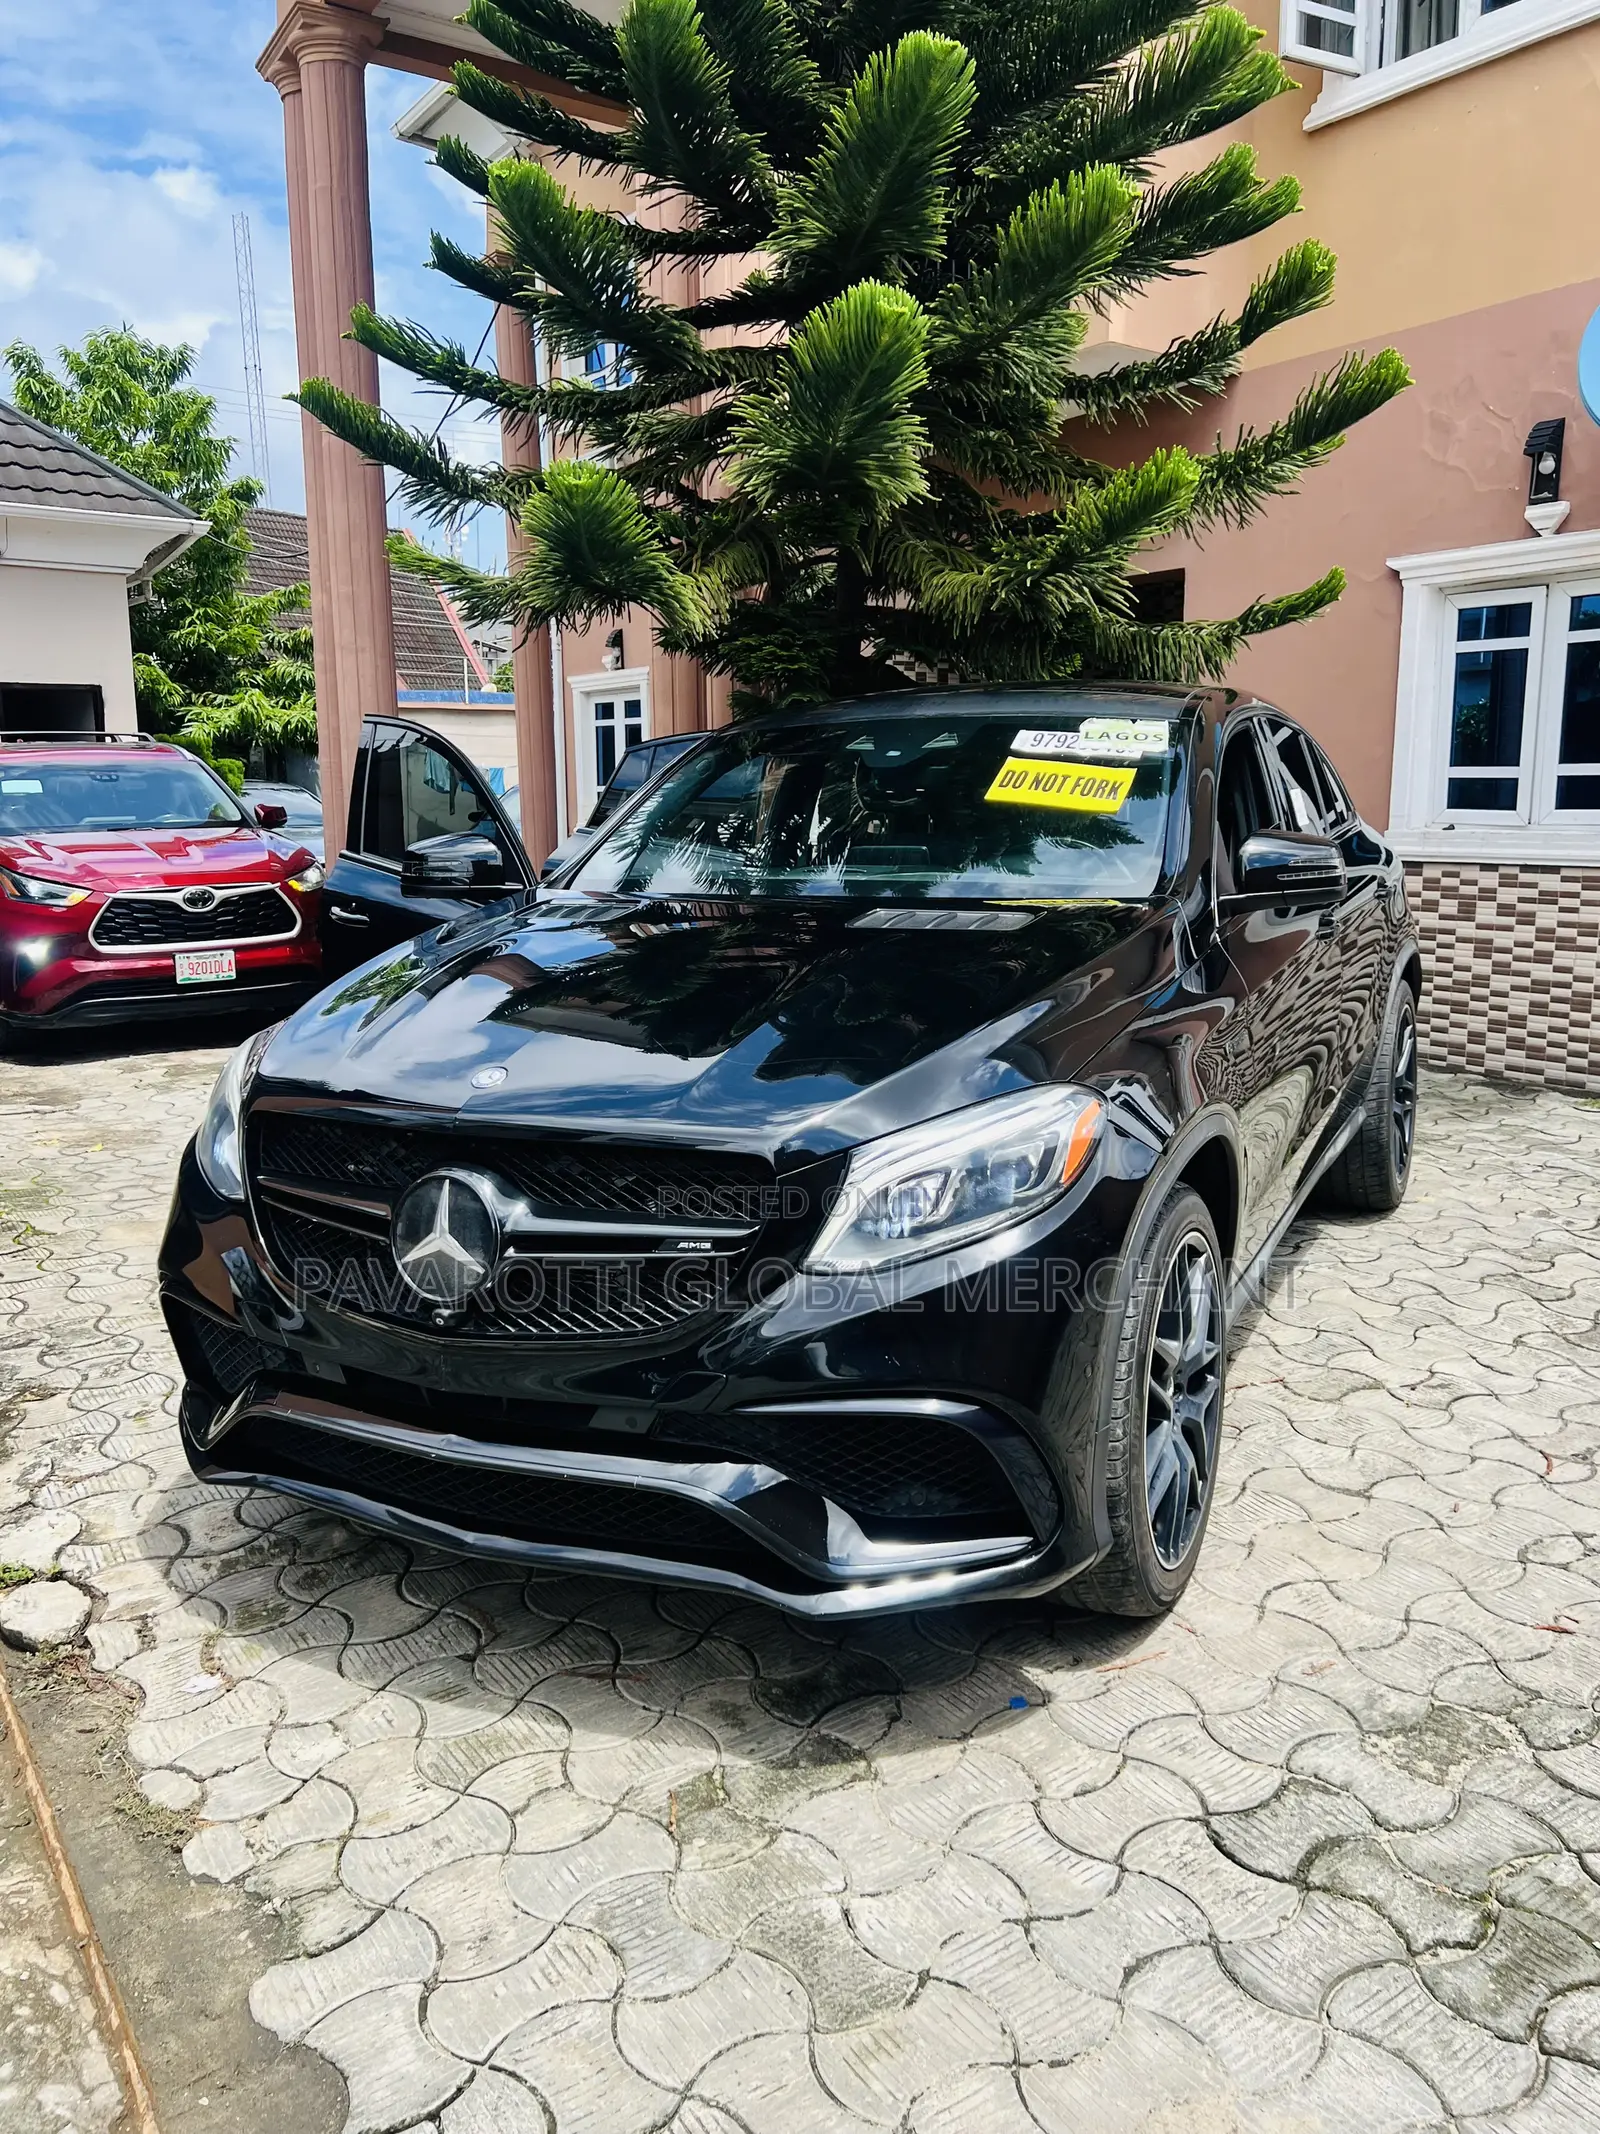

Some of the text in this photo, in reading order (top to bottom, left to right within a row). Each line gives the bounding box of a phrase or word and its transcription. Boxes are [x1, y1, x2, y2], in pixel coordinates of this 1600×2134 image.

[1084, 731, 1164, 742] LAGOS
[998, 769, 1123, 800] DO NOT FORK
[188, 960, 233, 975] 9201DLA
